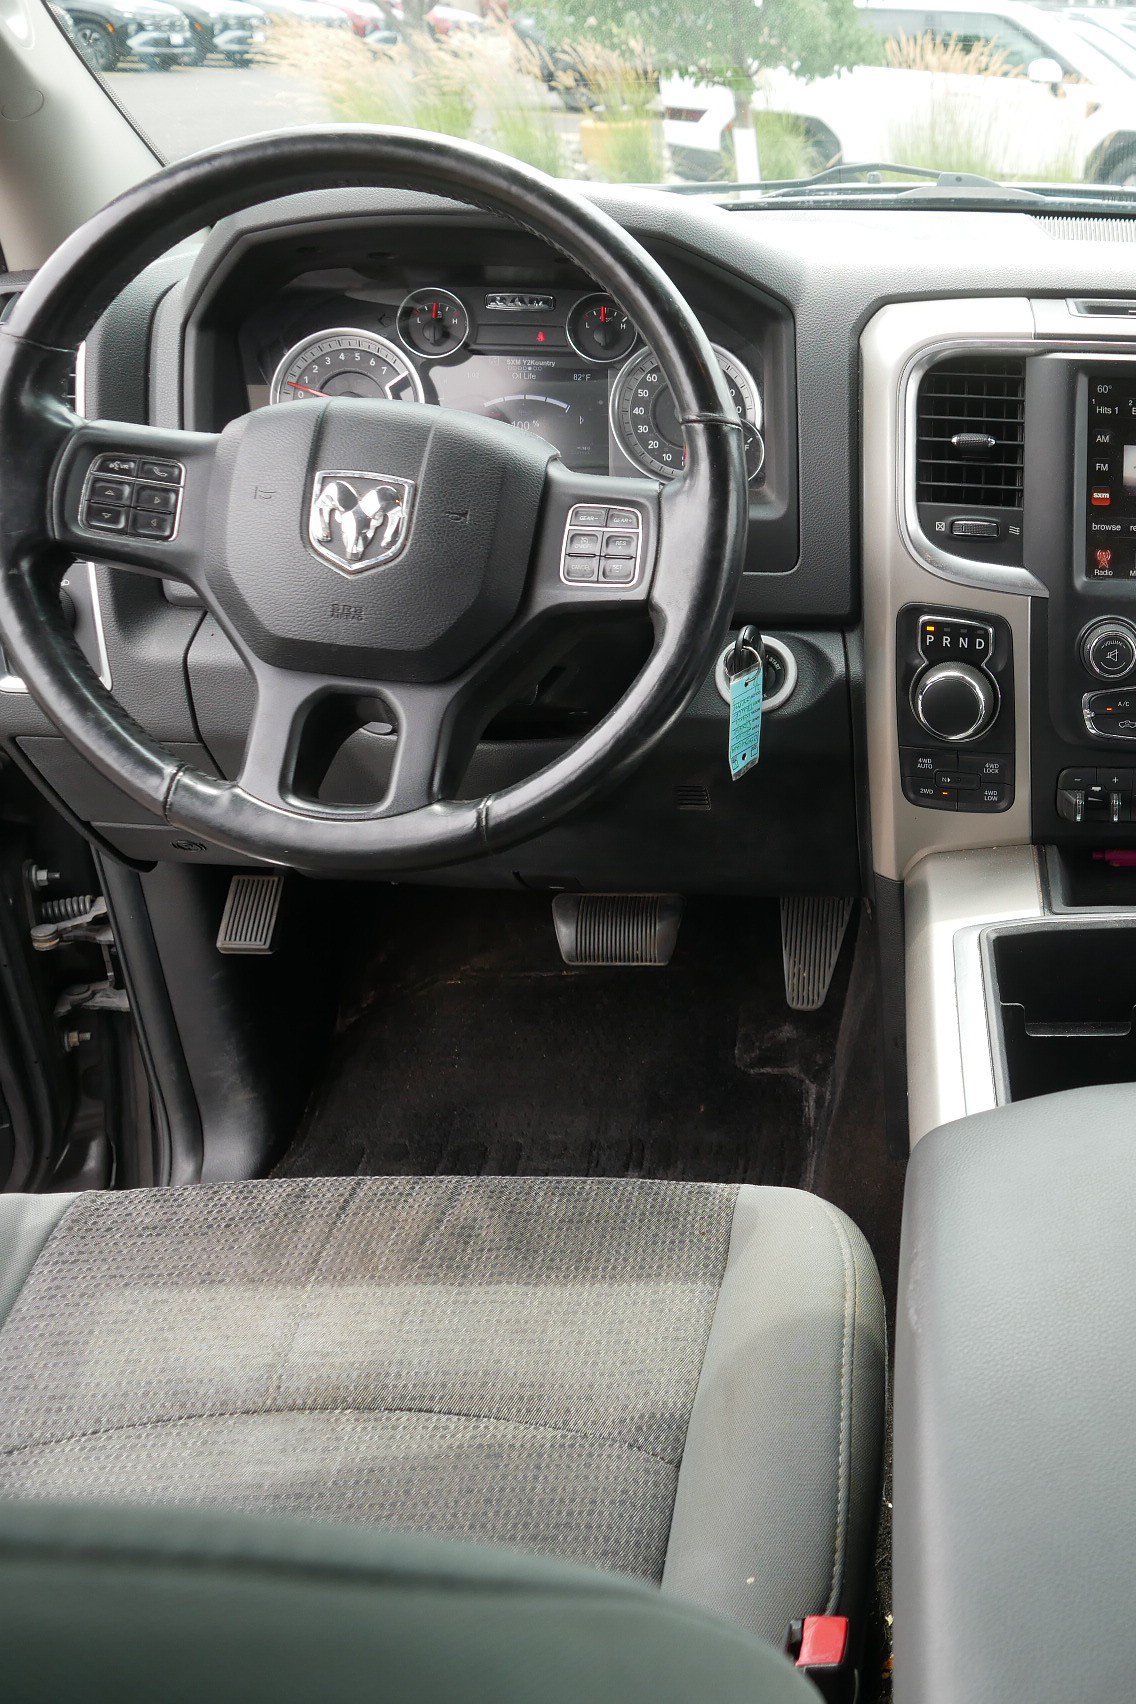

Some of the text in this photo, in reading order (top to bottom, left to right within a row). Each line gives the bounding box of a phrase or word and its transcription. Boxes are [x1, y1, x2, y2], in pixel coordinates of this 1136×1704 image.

[325, 357, 331, 365] 3
[370, 358, 376, 366] 6
[523, 359, 556, 367] Y2Kountry
[313, 365, 319, 373] 2
[381, 367, 387, 375] 7
[304, 376, 308, 384] 1
[523, 372, 537, 380] Life
[646, 374, 657, 382] 60
[298, 391, 304, 399] 0
[638, 389, 649, 397] 50
[633, 407, 645, 415] 40
[1096, 406, 1112, 414] Hits
[637, 425, 648, 433] 30
[1096, 434, 1110, 443] AM
[648, 441, 659, 449] 20
[662, 453, 672, 461] 10
[1095, 463, 1109, 471] FM
[1092, 522, 1122, 531] browse
[926, 635, 985, 650] P R N D
[920, 787, 934, 795] 2WD
